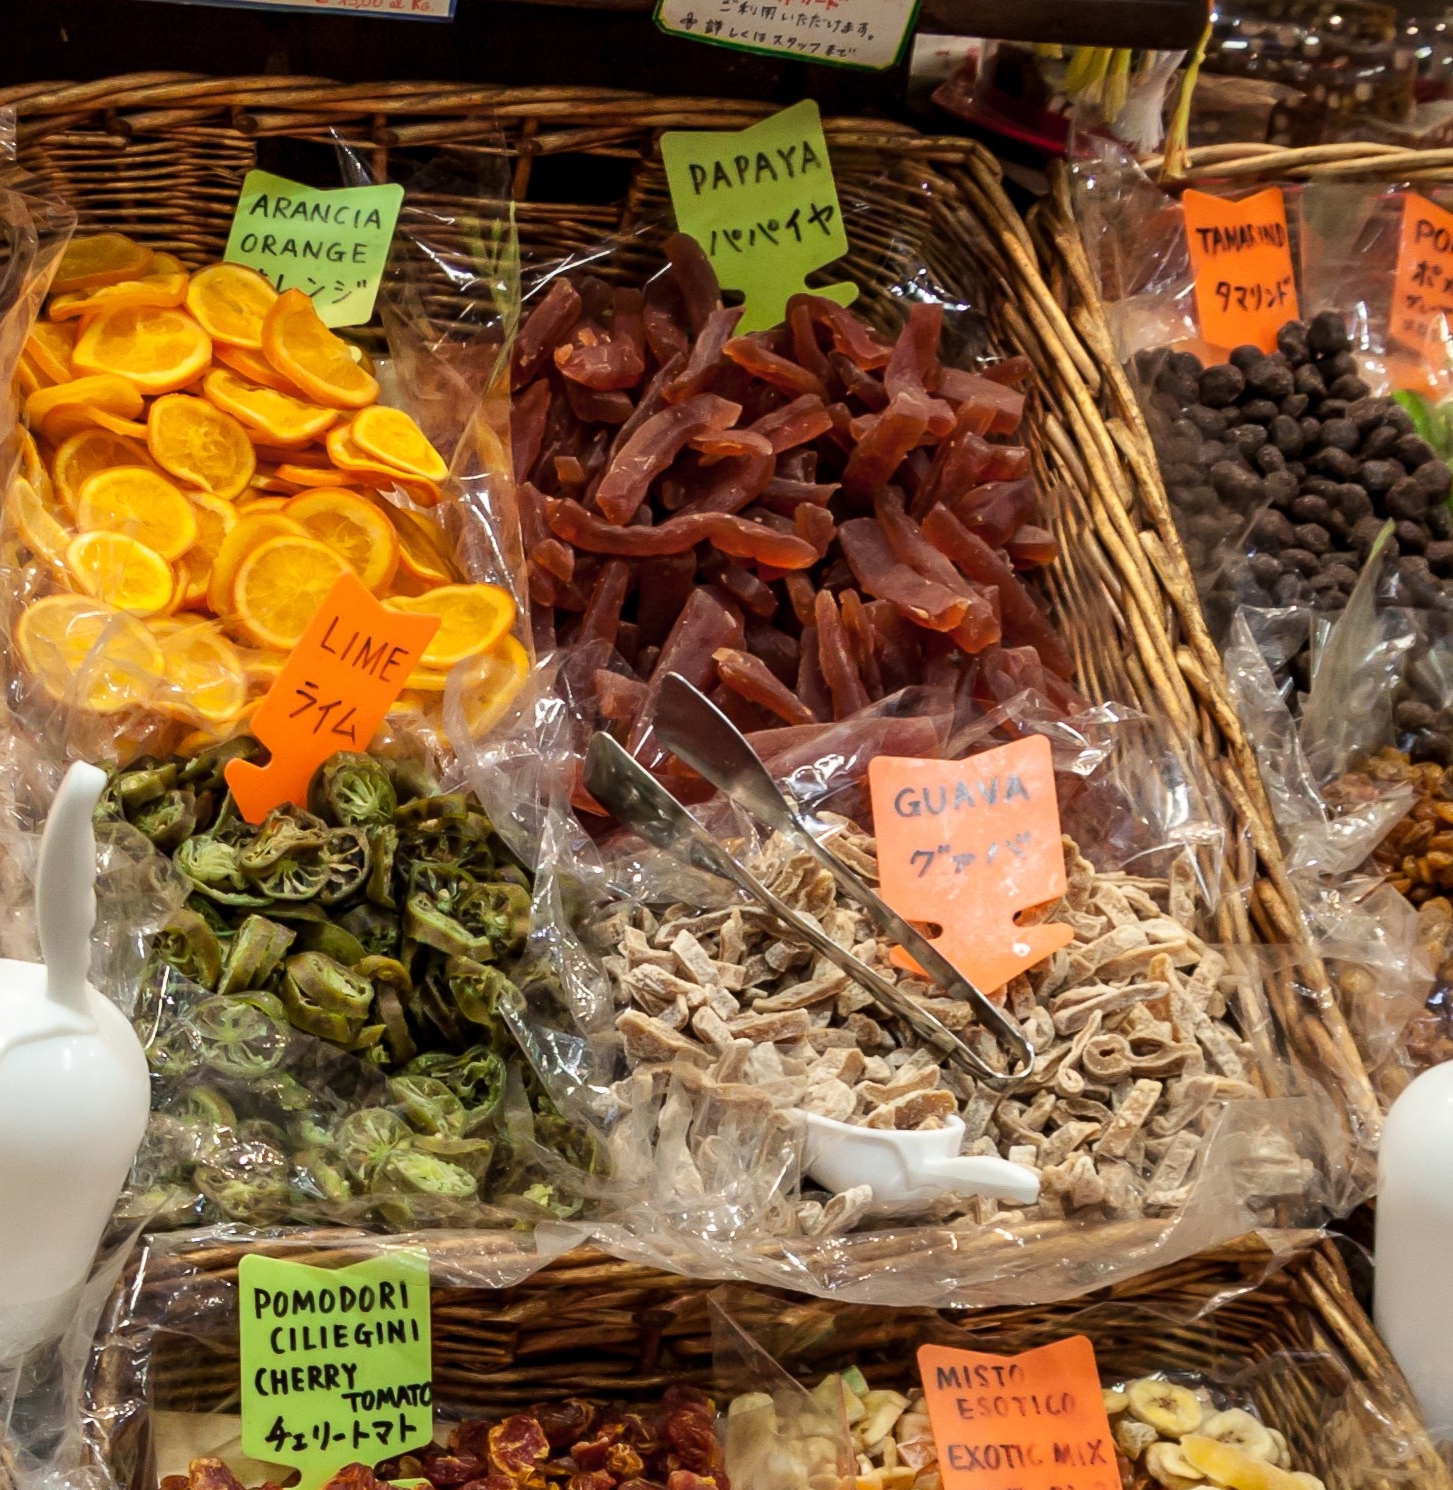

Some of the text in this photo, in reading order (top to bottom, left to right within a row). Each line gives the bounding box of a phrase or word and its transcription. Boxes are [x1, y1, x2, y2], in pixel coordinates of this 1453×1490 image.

[689, 140, 822, 195] PAPAYA
[249, 194, 381, 230] ARANCIA
[710, 203, 834, 256] パパイヤ
[240, 233, 368, 264] ORANGE
[1215, 276, 1291, 312] タマリンド
[320, 616, 410, 682] LIME
[289, 681, 357, 745] ライム
[894, 774, 1031, 818] GUAVA
[254, 1280, 409, 1319] POMODORI
[270, 1318, 420, 1354] CILIEGINI
[254, 1363, 433, 1413] CHERRY TOMATO
[936, 1364, 1025, 1391] MISTO
[957, 1392, 1077, 1421] ESOTICO
[265, 1413, 417, 1452] チェリートマト
[948, 1438, 1107, 1472] EXOTIC MIX
